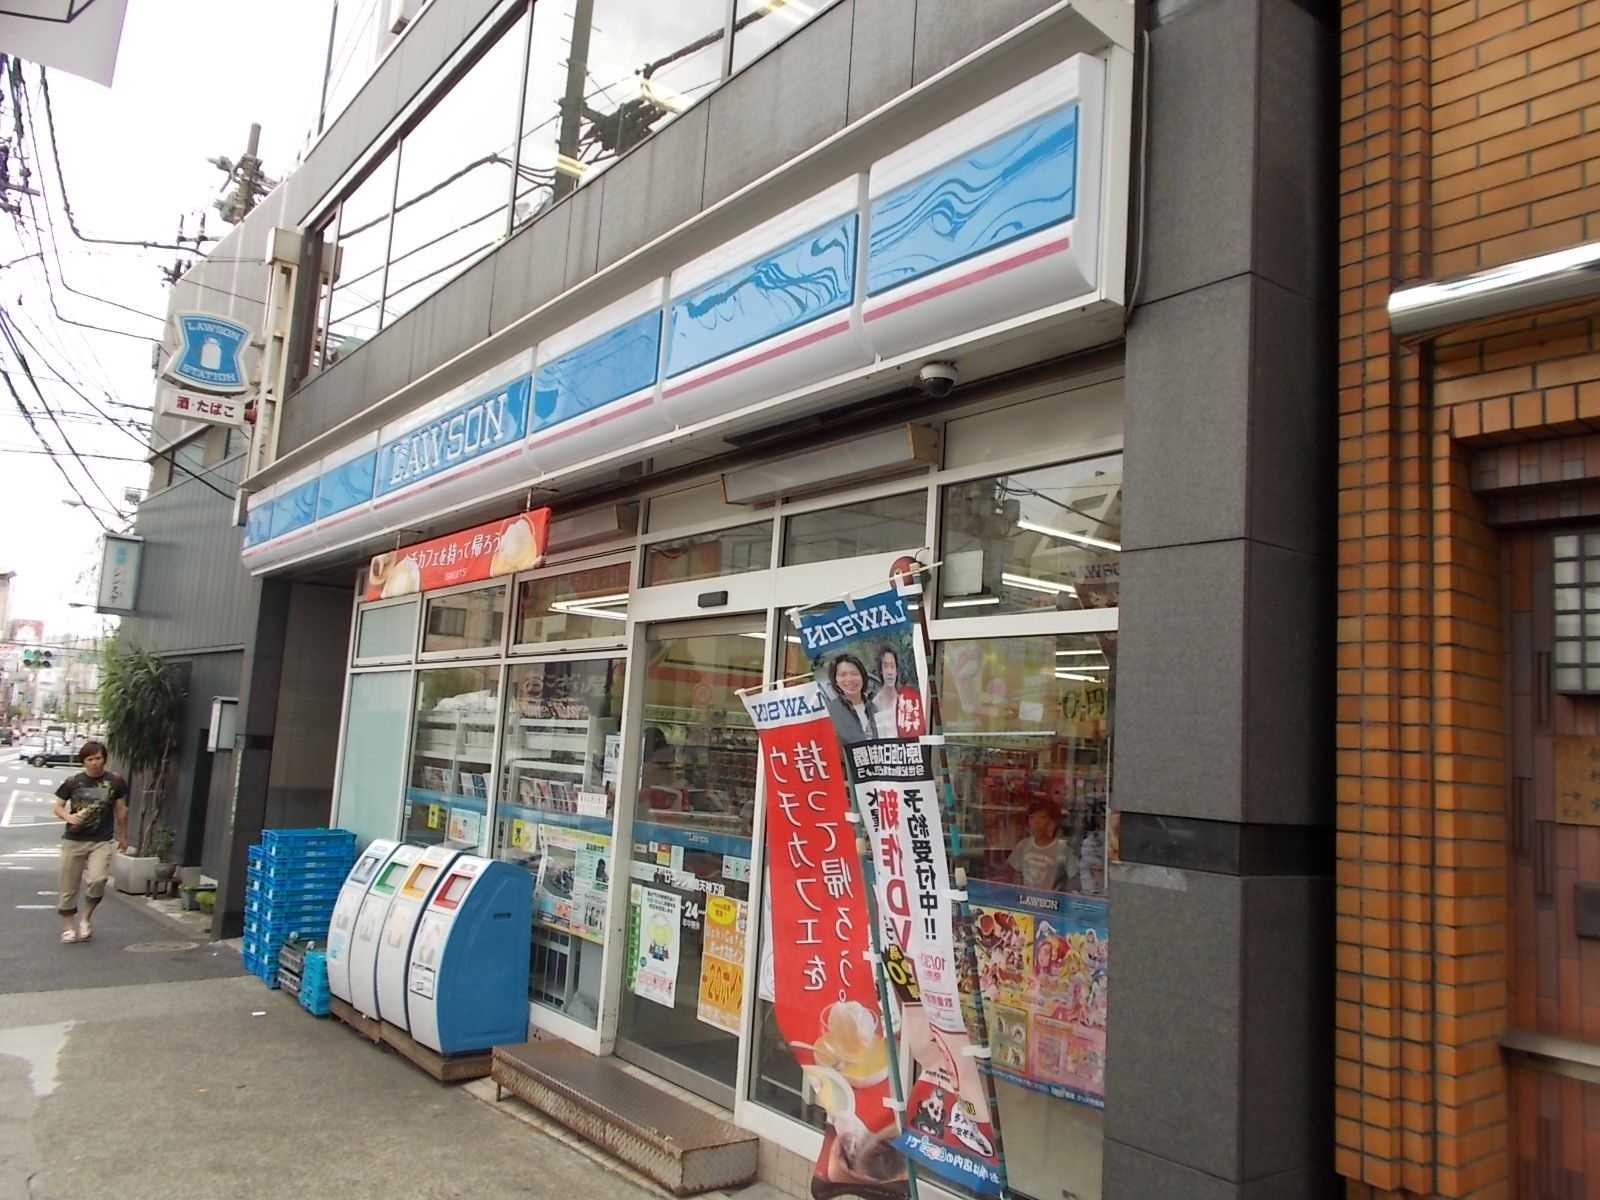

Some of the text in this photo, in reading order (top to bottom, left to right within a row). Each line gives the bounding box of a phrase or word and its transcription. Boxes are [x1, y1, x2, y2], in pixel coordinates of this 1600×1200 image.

[187, 321, 242, 341] LAWSON
[181, 363, 237, 382] STATION
[389, 392, 508, 486] LAWSON
[684, 901, 698, 919] 24
[1019, 894, 1058, 909] LAWSON
